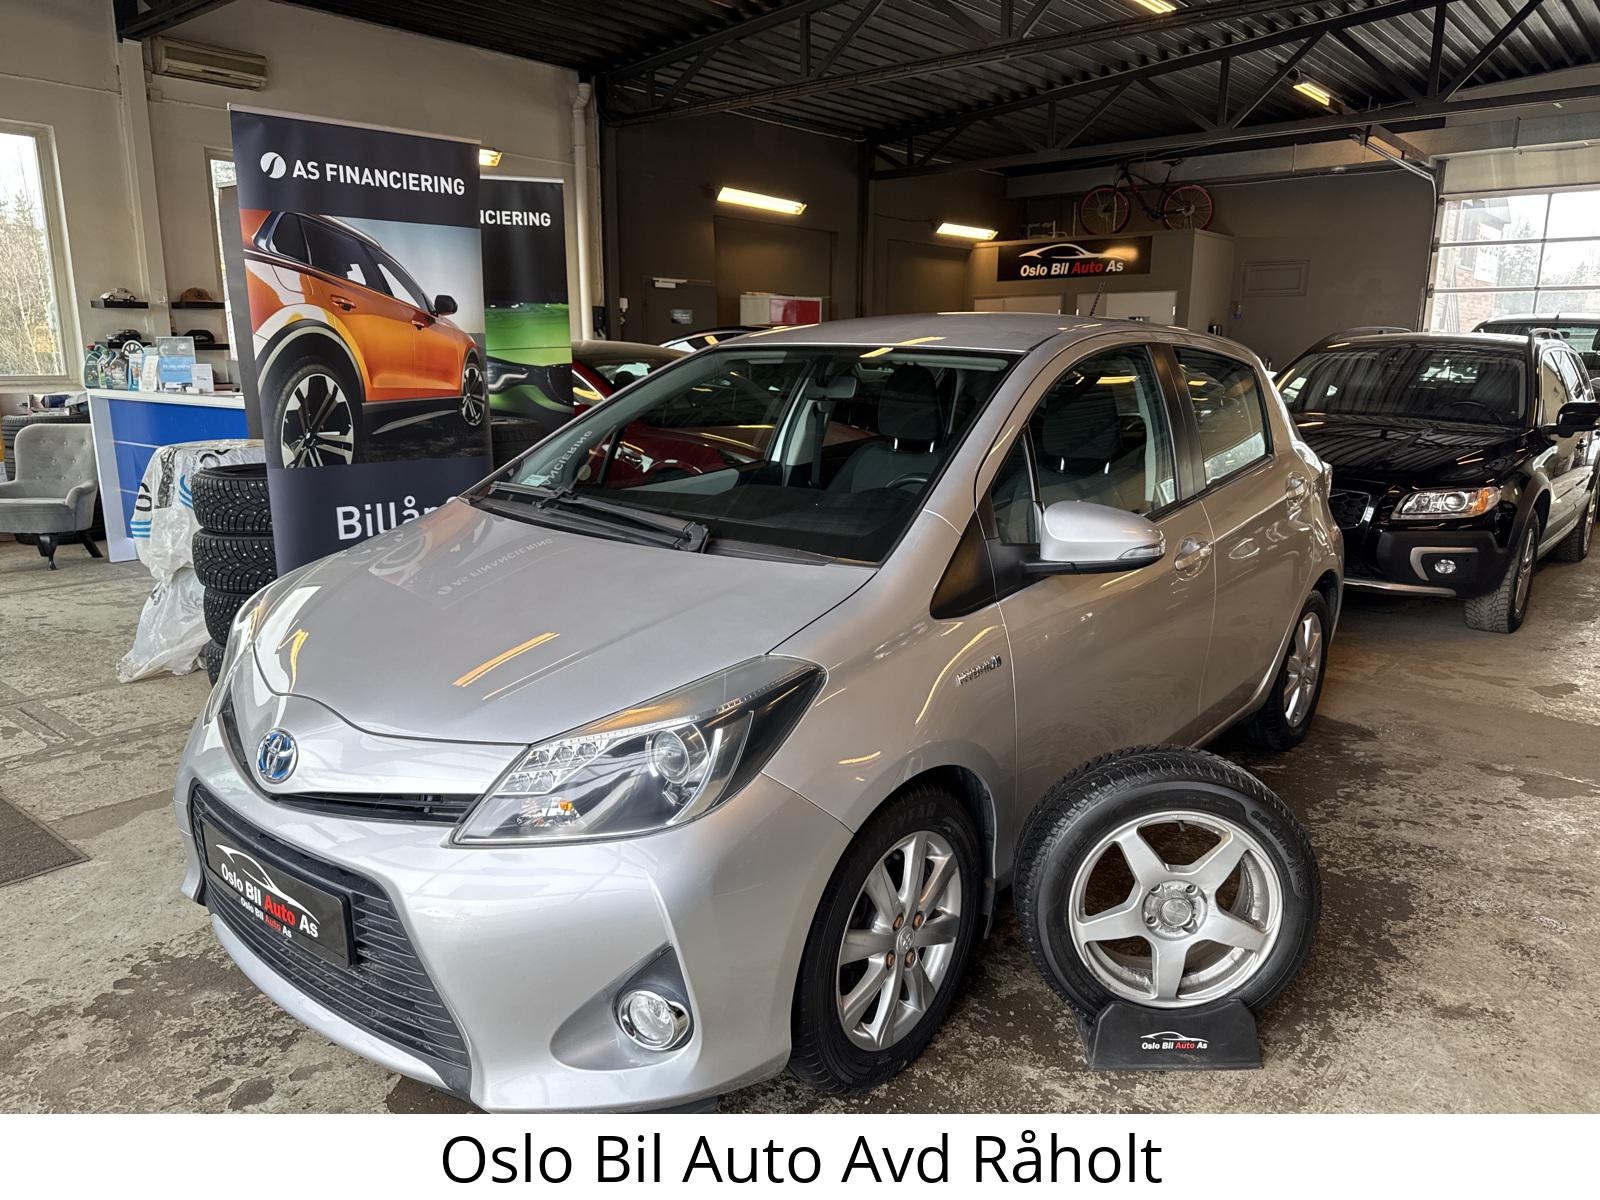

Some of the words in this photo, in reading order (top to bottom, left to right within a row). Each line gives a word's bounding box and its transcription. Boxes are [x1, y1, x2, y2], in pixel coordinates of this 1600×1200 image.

[292, 159, 320, 181] AS
[325, 162, 465, 196] FINANCIERING
[1020, 264, 1048, 277] Oslo
[1051, 262, 1070, 275] Bil
[1071, 261, 1104, 274] Auto
[1106, 260, 1124, 272] As
[336, 495, 470, 540] Billå
[221, 863, 243, 892] Oslo
[264, 895, 296, 926] Auto
[299, 913, 319, 938] As
[240, 897, 254, 913] Oslo
[264, 915, 283, 933] Auto
[282, 925, 292, 938] As
[1141, 1042, 1160, 1050] Oslo
[1162, 1042, 1174, 1050] Bil
[1175, 1042, 1195, 1050] Auto
